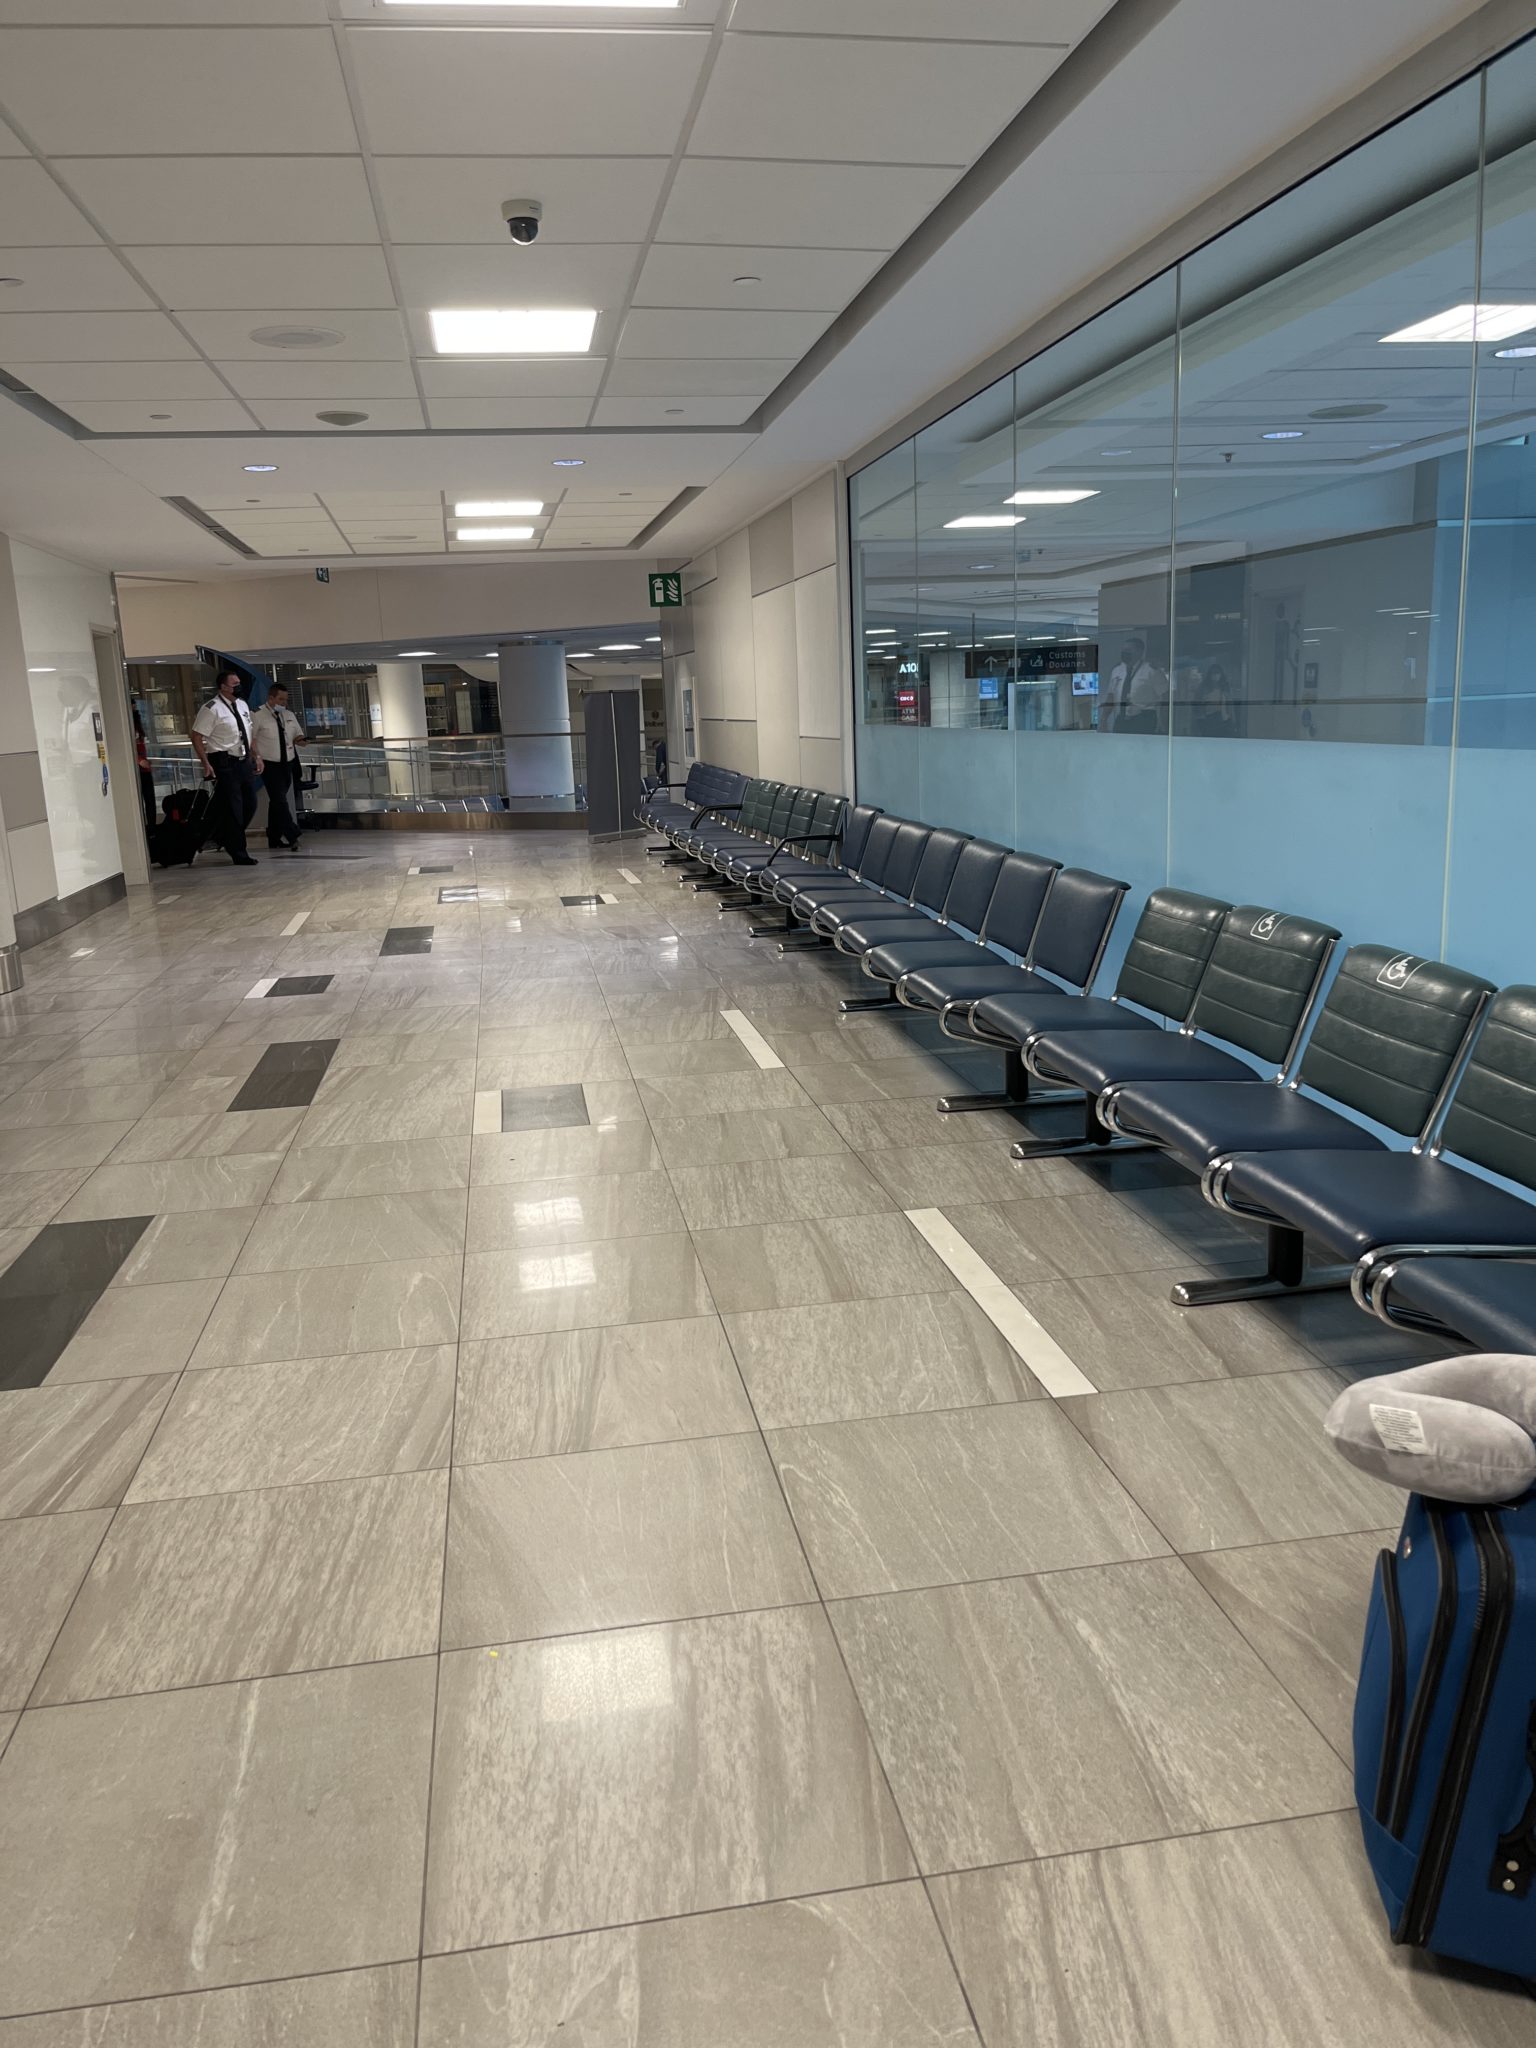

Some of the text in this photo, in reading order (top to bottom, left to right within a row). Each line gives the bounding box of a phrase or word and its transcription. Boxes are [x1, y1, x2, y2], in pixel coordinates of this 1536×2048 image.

[1048, 651, 1086, 660] Customs
[899, 662, 919, 674] A10
[1048, 660, 1086, 669] Douanes
